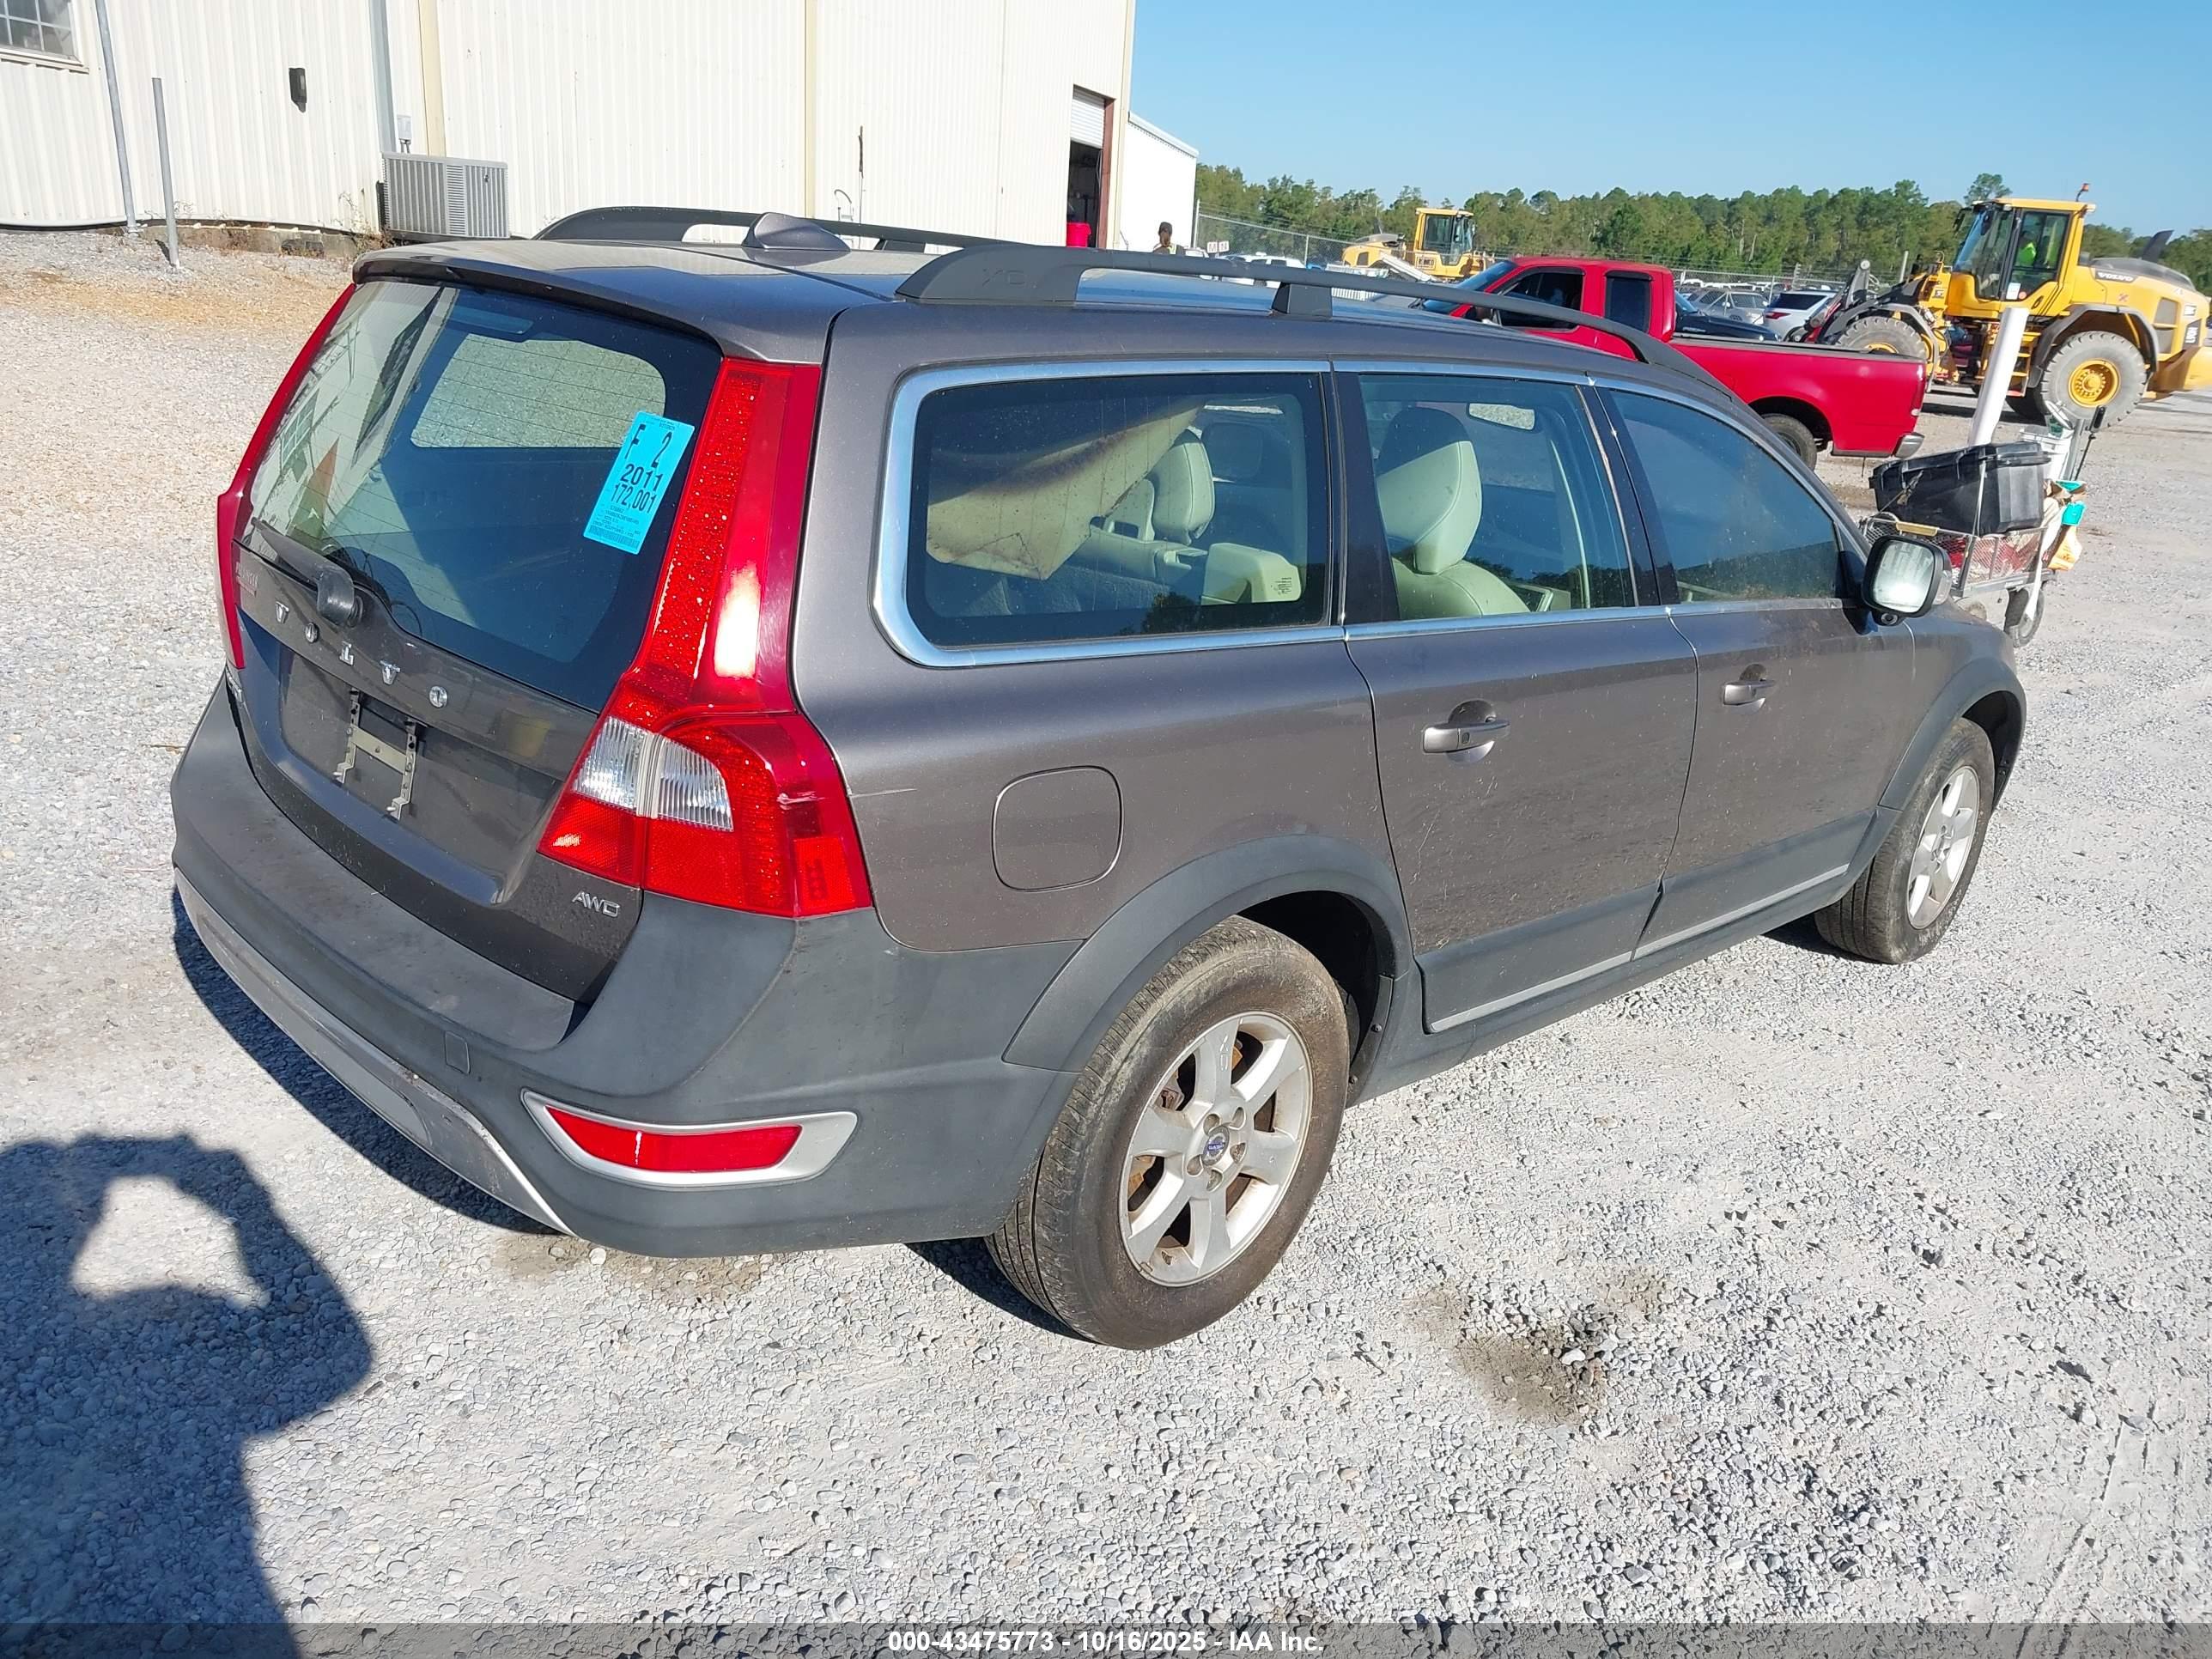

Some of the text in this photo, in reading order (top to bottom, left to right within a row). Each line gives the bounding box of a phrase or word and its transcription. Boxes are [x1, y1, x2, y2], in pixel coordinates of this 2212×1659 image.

[2097, 271, 2134, 282] VOLVO
[624, 423, 672, 468] F 2
[620, 464, 663, 491] 2011
[611, 483, 657, 514] 172,001
[275, 601, 448, 708] VOLVO
[572, 891, 620, 917] AWD
